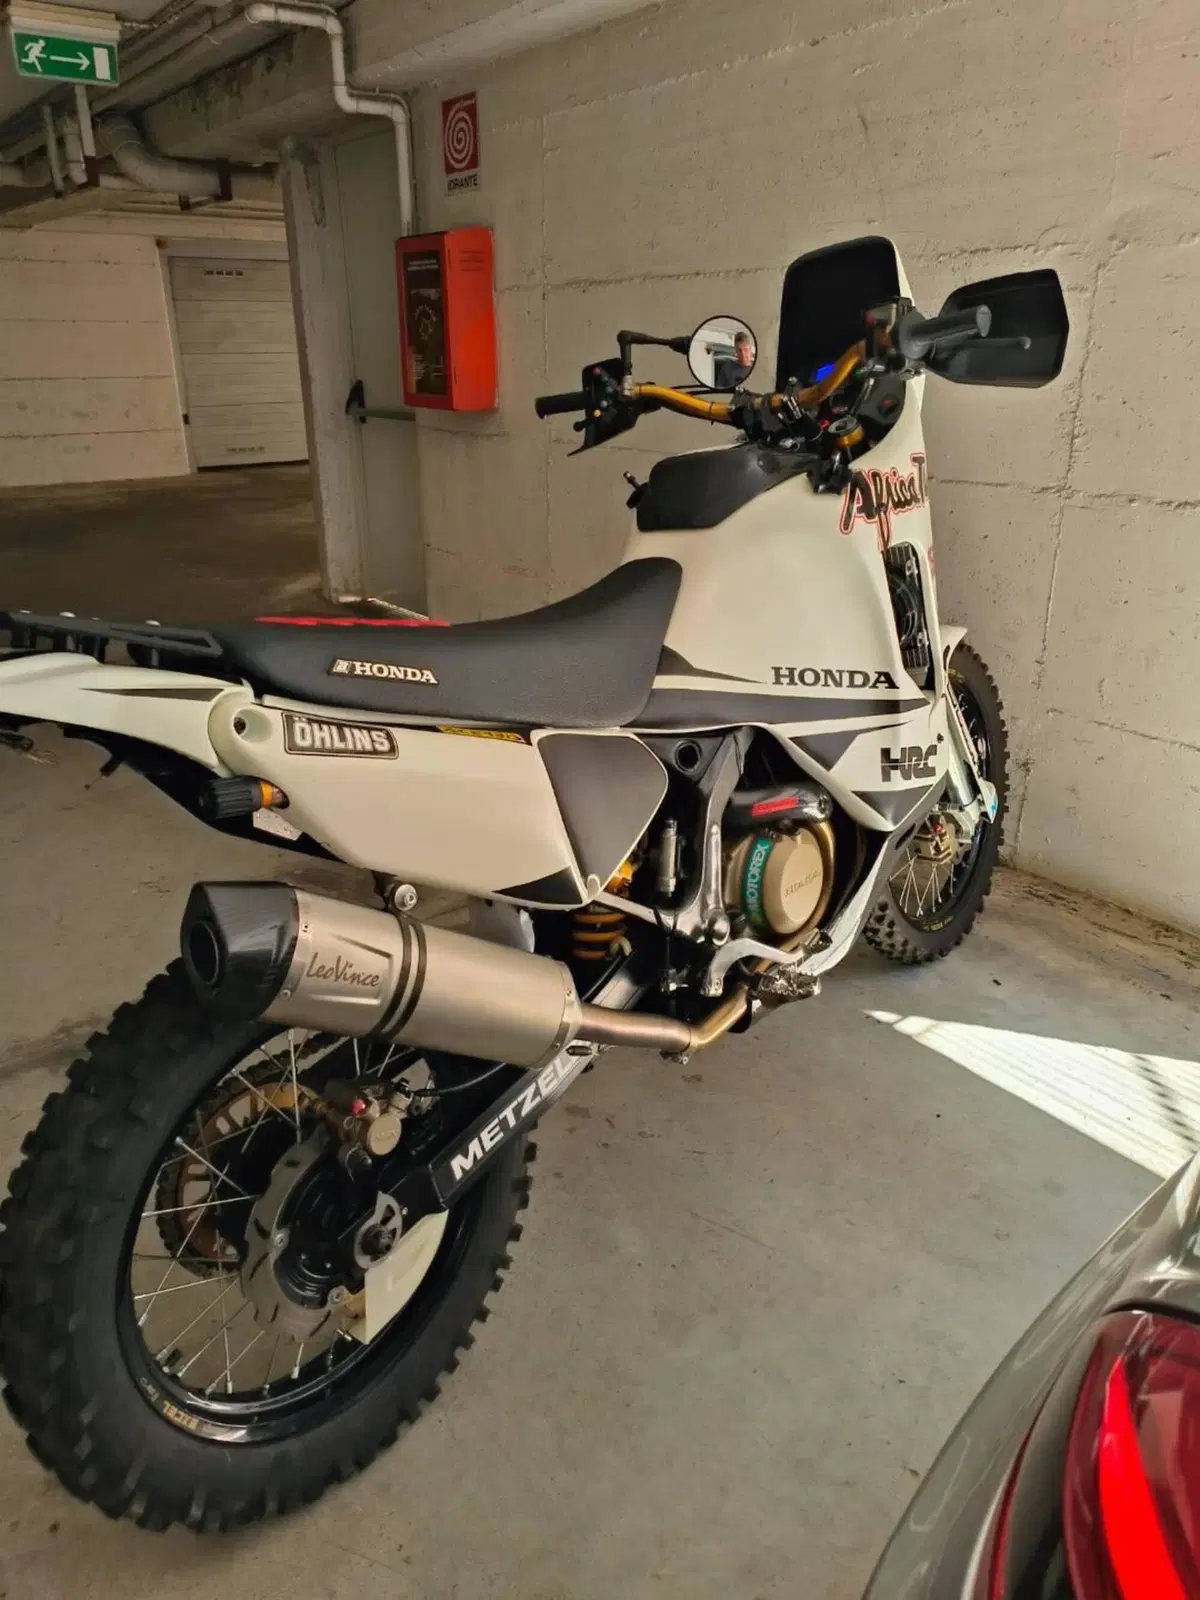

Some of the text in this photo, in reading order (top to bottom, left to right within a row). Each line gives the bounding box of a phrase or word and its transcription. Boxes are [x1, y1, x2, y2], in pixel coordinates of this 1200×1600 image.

[353, 660, 438, 684] HONDA
[771, 666, 900, 690] HONDA
[293, 715, 392, 752] ÖHLINS
[880, 744, 938, 782] HRC
[746, 843, 769, 912] MOTOREX
[306, 951, 381, 987] LeoVince
